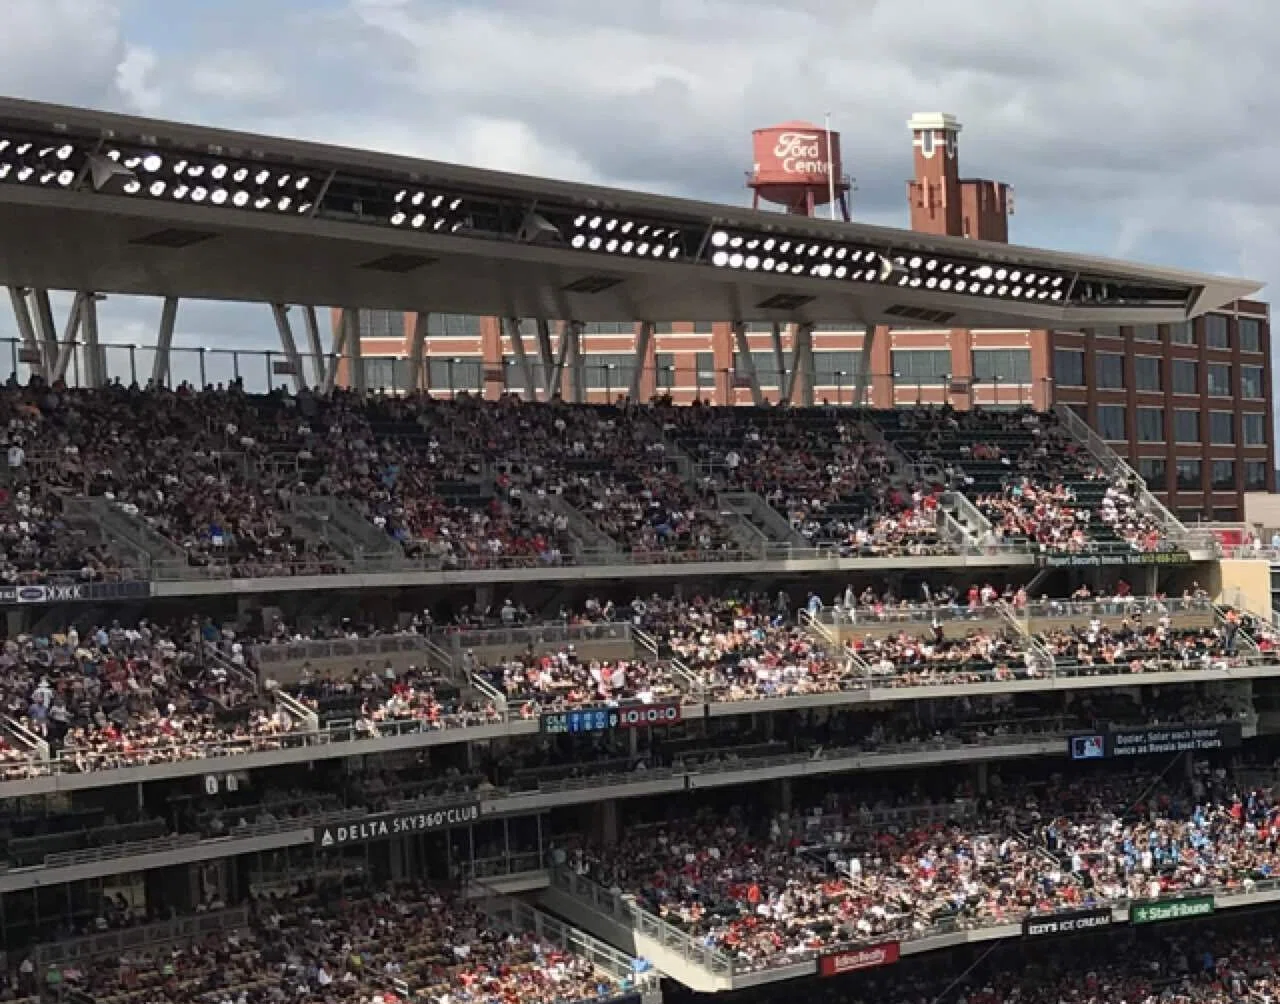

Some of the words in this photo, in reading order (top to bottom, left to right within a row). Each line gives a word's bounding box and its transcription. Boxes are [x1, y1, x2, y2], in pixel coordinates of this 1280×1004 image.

[774, 131, 819, 157] Ford
[337, 820, 389, 842] DELTA
[447, 805, 479, 824] CLUB
[1060, 920, 1075, 932] ICE
[1076, 914, 1111, 929] CREAM
